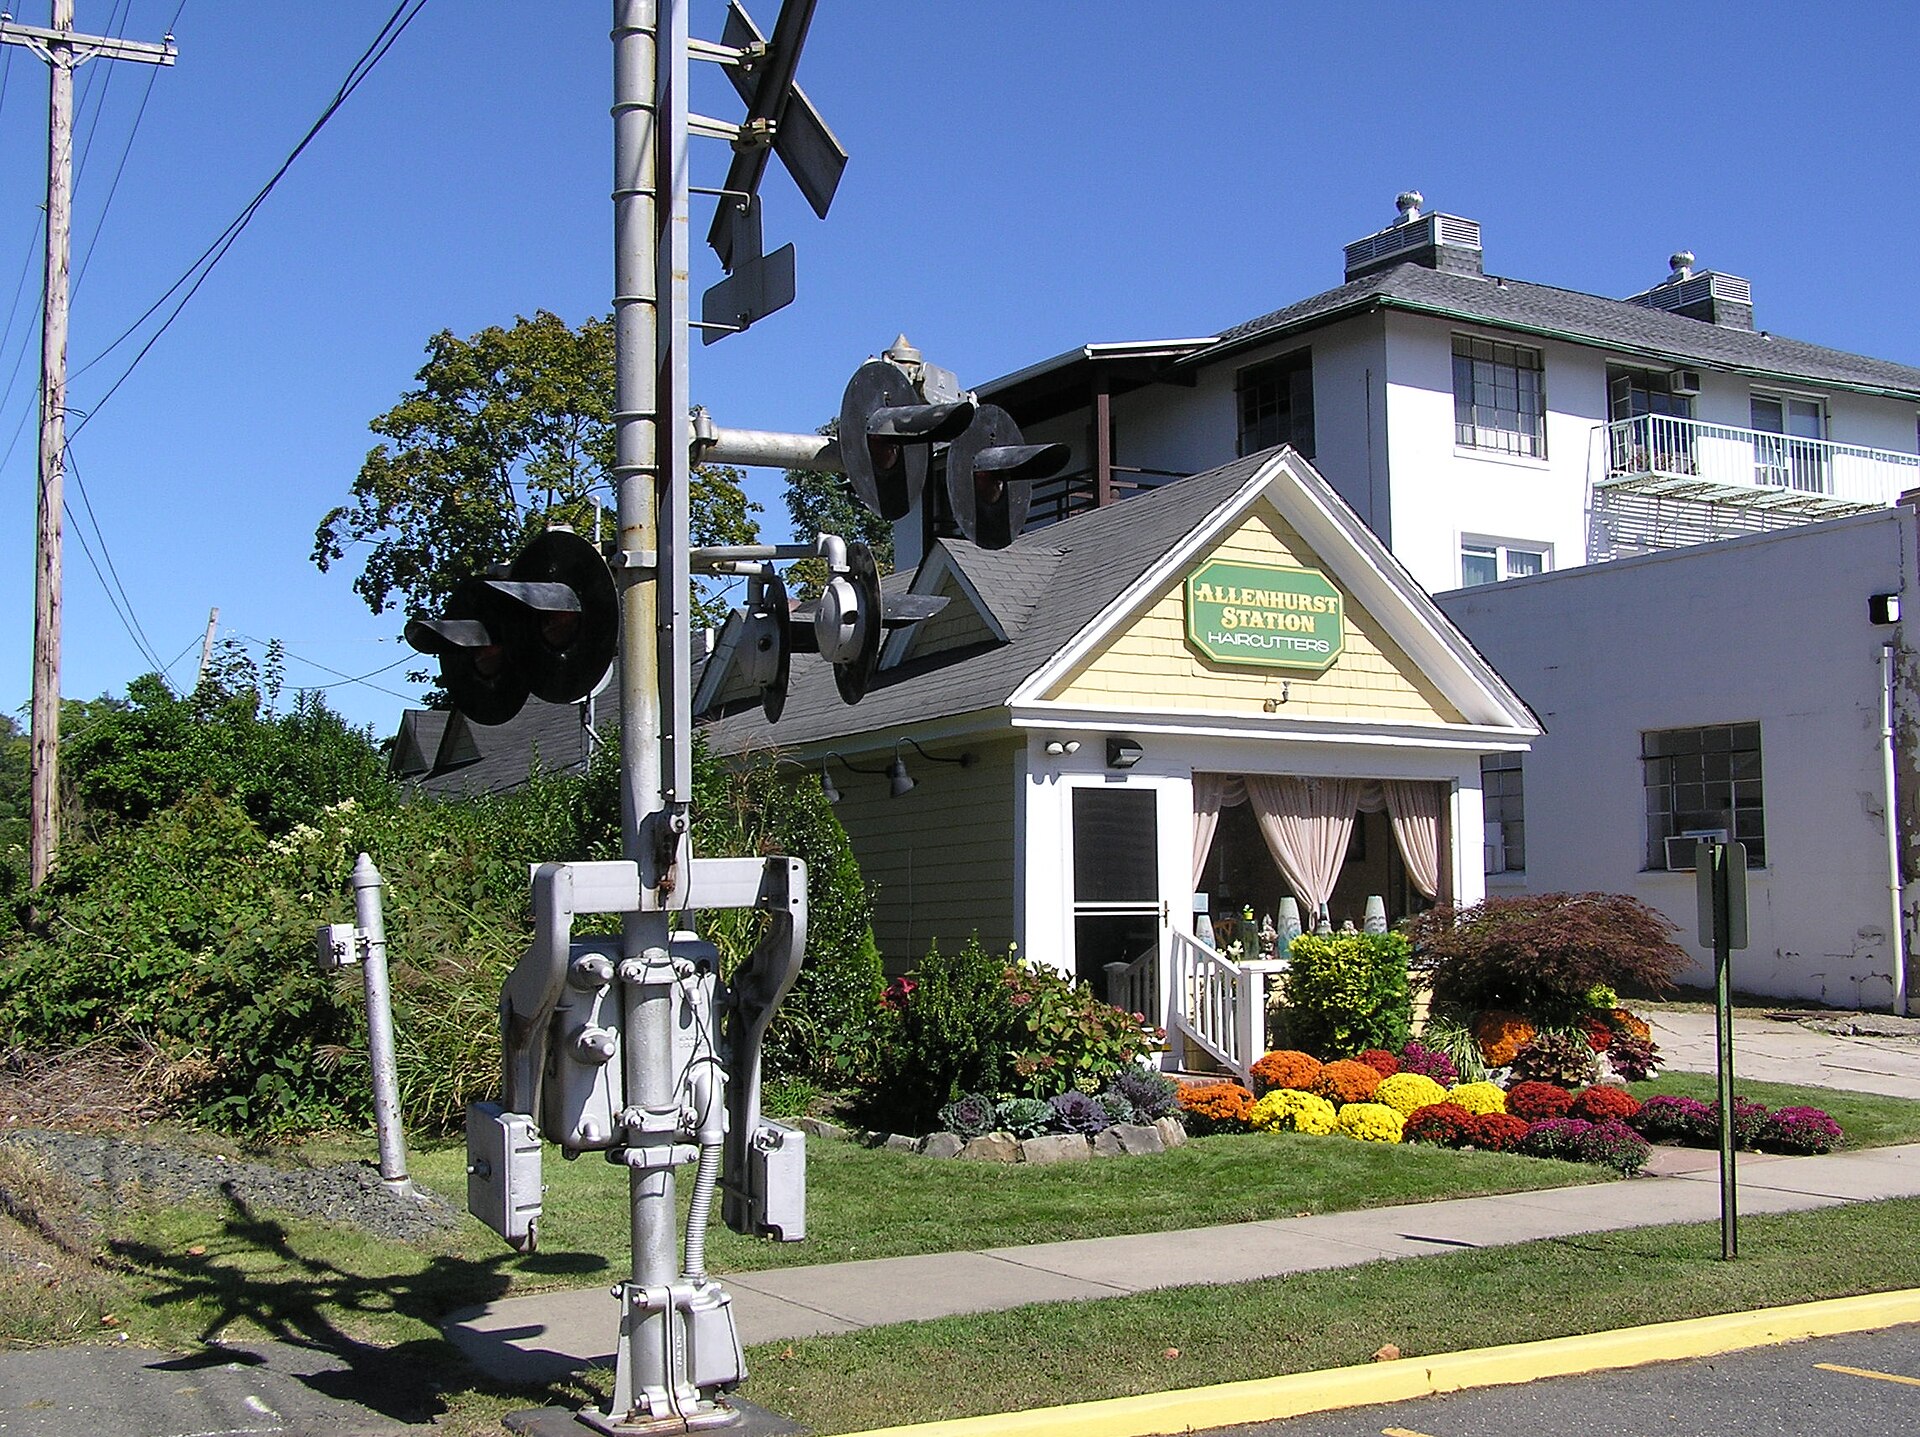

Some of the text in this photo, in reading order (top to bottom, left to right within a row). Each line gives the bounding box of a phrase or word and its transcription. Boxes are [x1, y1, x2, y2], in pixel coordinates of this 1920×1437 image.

[1194, 582, 1338, 614] ALLENHURST
[1220, 606, 1315, 633] STATION
[1208, 631, 1330, 653] HAIRCUTTERS
